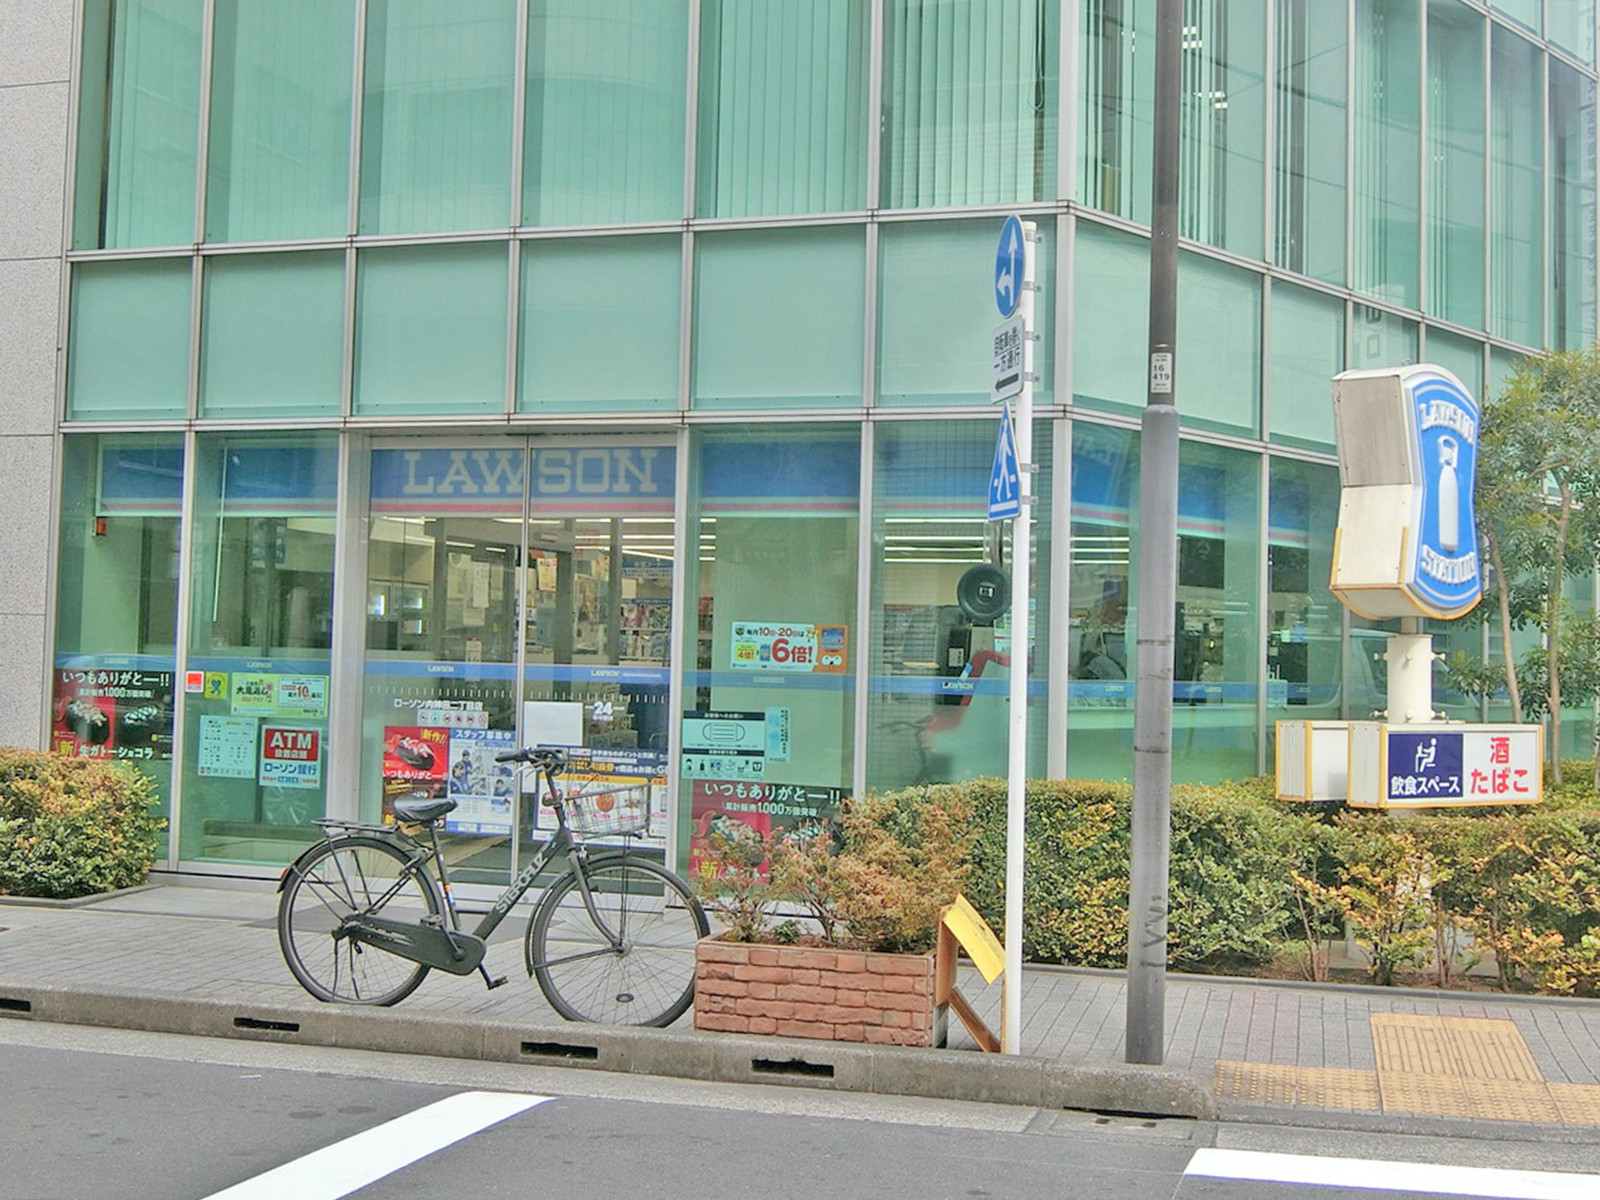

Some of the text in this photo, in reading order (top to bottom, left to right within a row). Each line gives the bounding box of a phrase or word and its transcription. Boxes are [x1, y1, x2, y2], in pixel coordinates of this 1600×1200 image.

[1419, 399, 1477, 446] LAWSON
[402, 450, 658, 495] LAWSON
[1422, 544, 1477, 585] STATION
[593, 701, 613, 716] 24
[269, 731, 313, 750] ATM
[1490, 737, 1511, 764] 酒
[263, 762, 318, 776] ローソン銀行
[1470, 767, 1529, 794] たばこ
[1390, 775, 1461, 796] 飲食スペース
